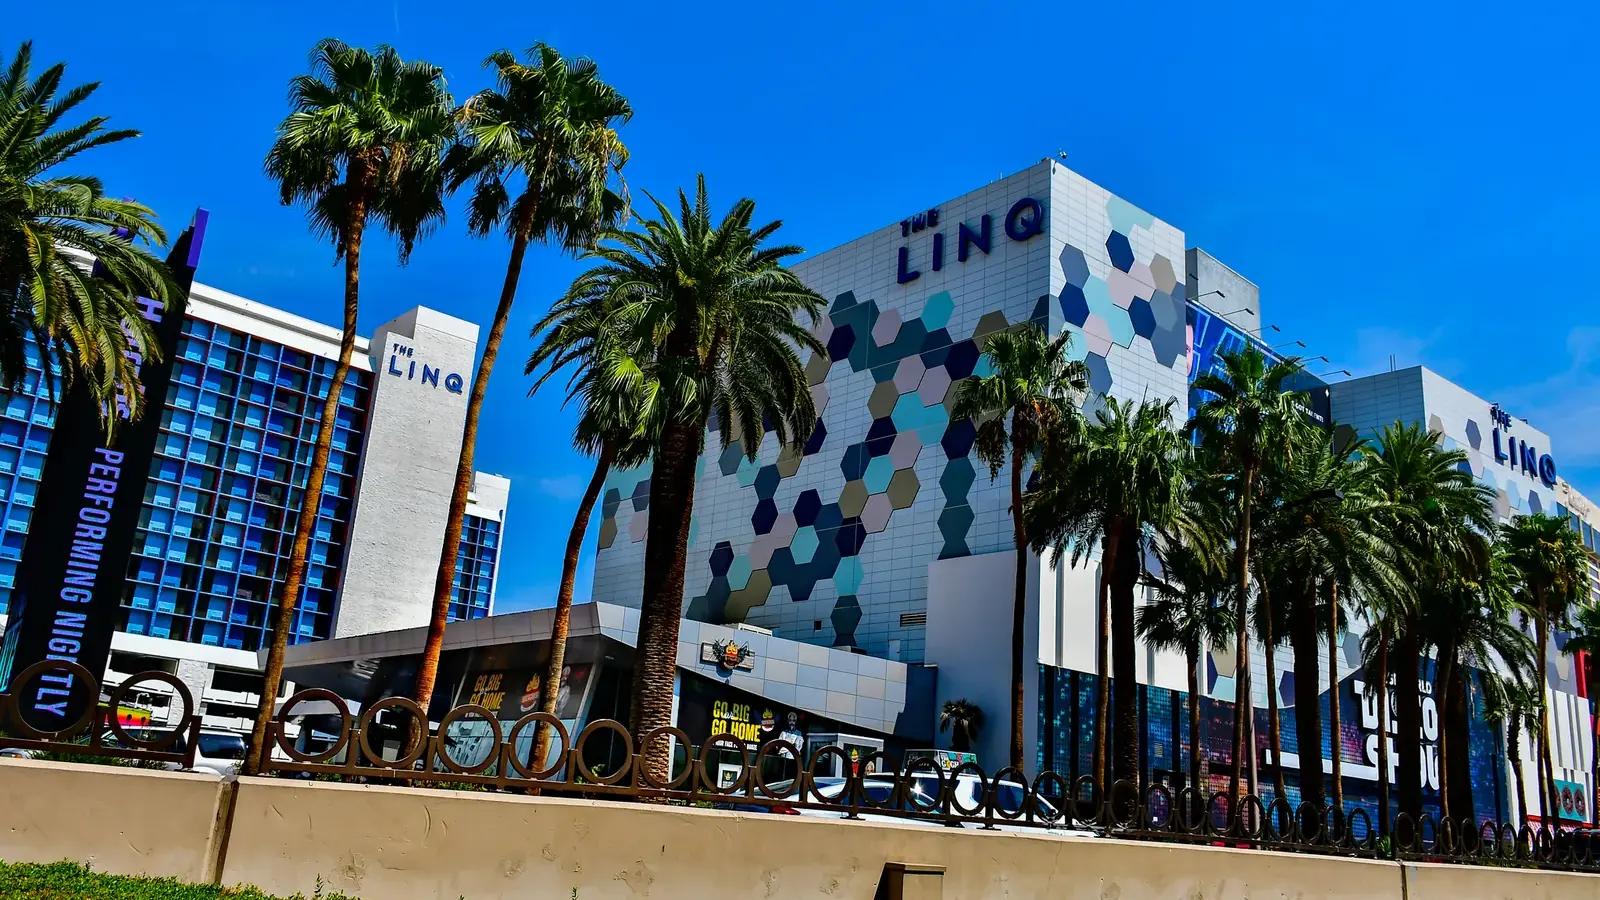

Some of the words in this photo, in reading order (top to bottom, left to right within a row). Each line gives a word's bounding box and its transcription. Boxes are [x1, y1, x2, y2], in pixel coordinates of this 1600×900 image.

[900, 208, 940, 237] THE
[897, 198, 1045, 284] LINQ
[393, 343, 414, 358] THE
[388, 355, 464, 395] LINQ
[1490, 406, 1512, 433] THE
[1492, 427, 1558, 491] LINQ
[60, 447, 124, 604] PERFORMING
[473, 674, 489, 692] GO
[487, 673, 503, 691] BIG
[469, 693, 481, 704] GO
[481, 692, 505, 710] HOME
[713, 700, 729, 719] GO
[731, 703, 751, 722] BIG
[711, 718, 727, 737] GO
[730, 721, 761, 743] HOME
